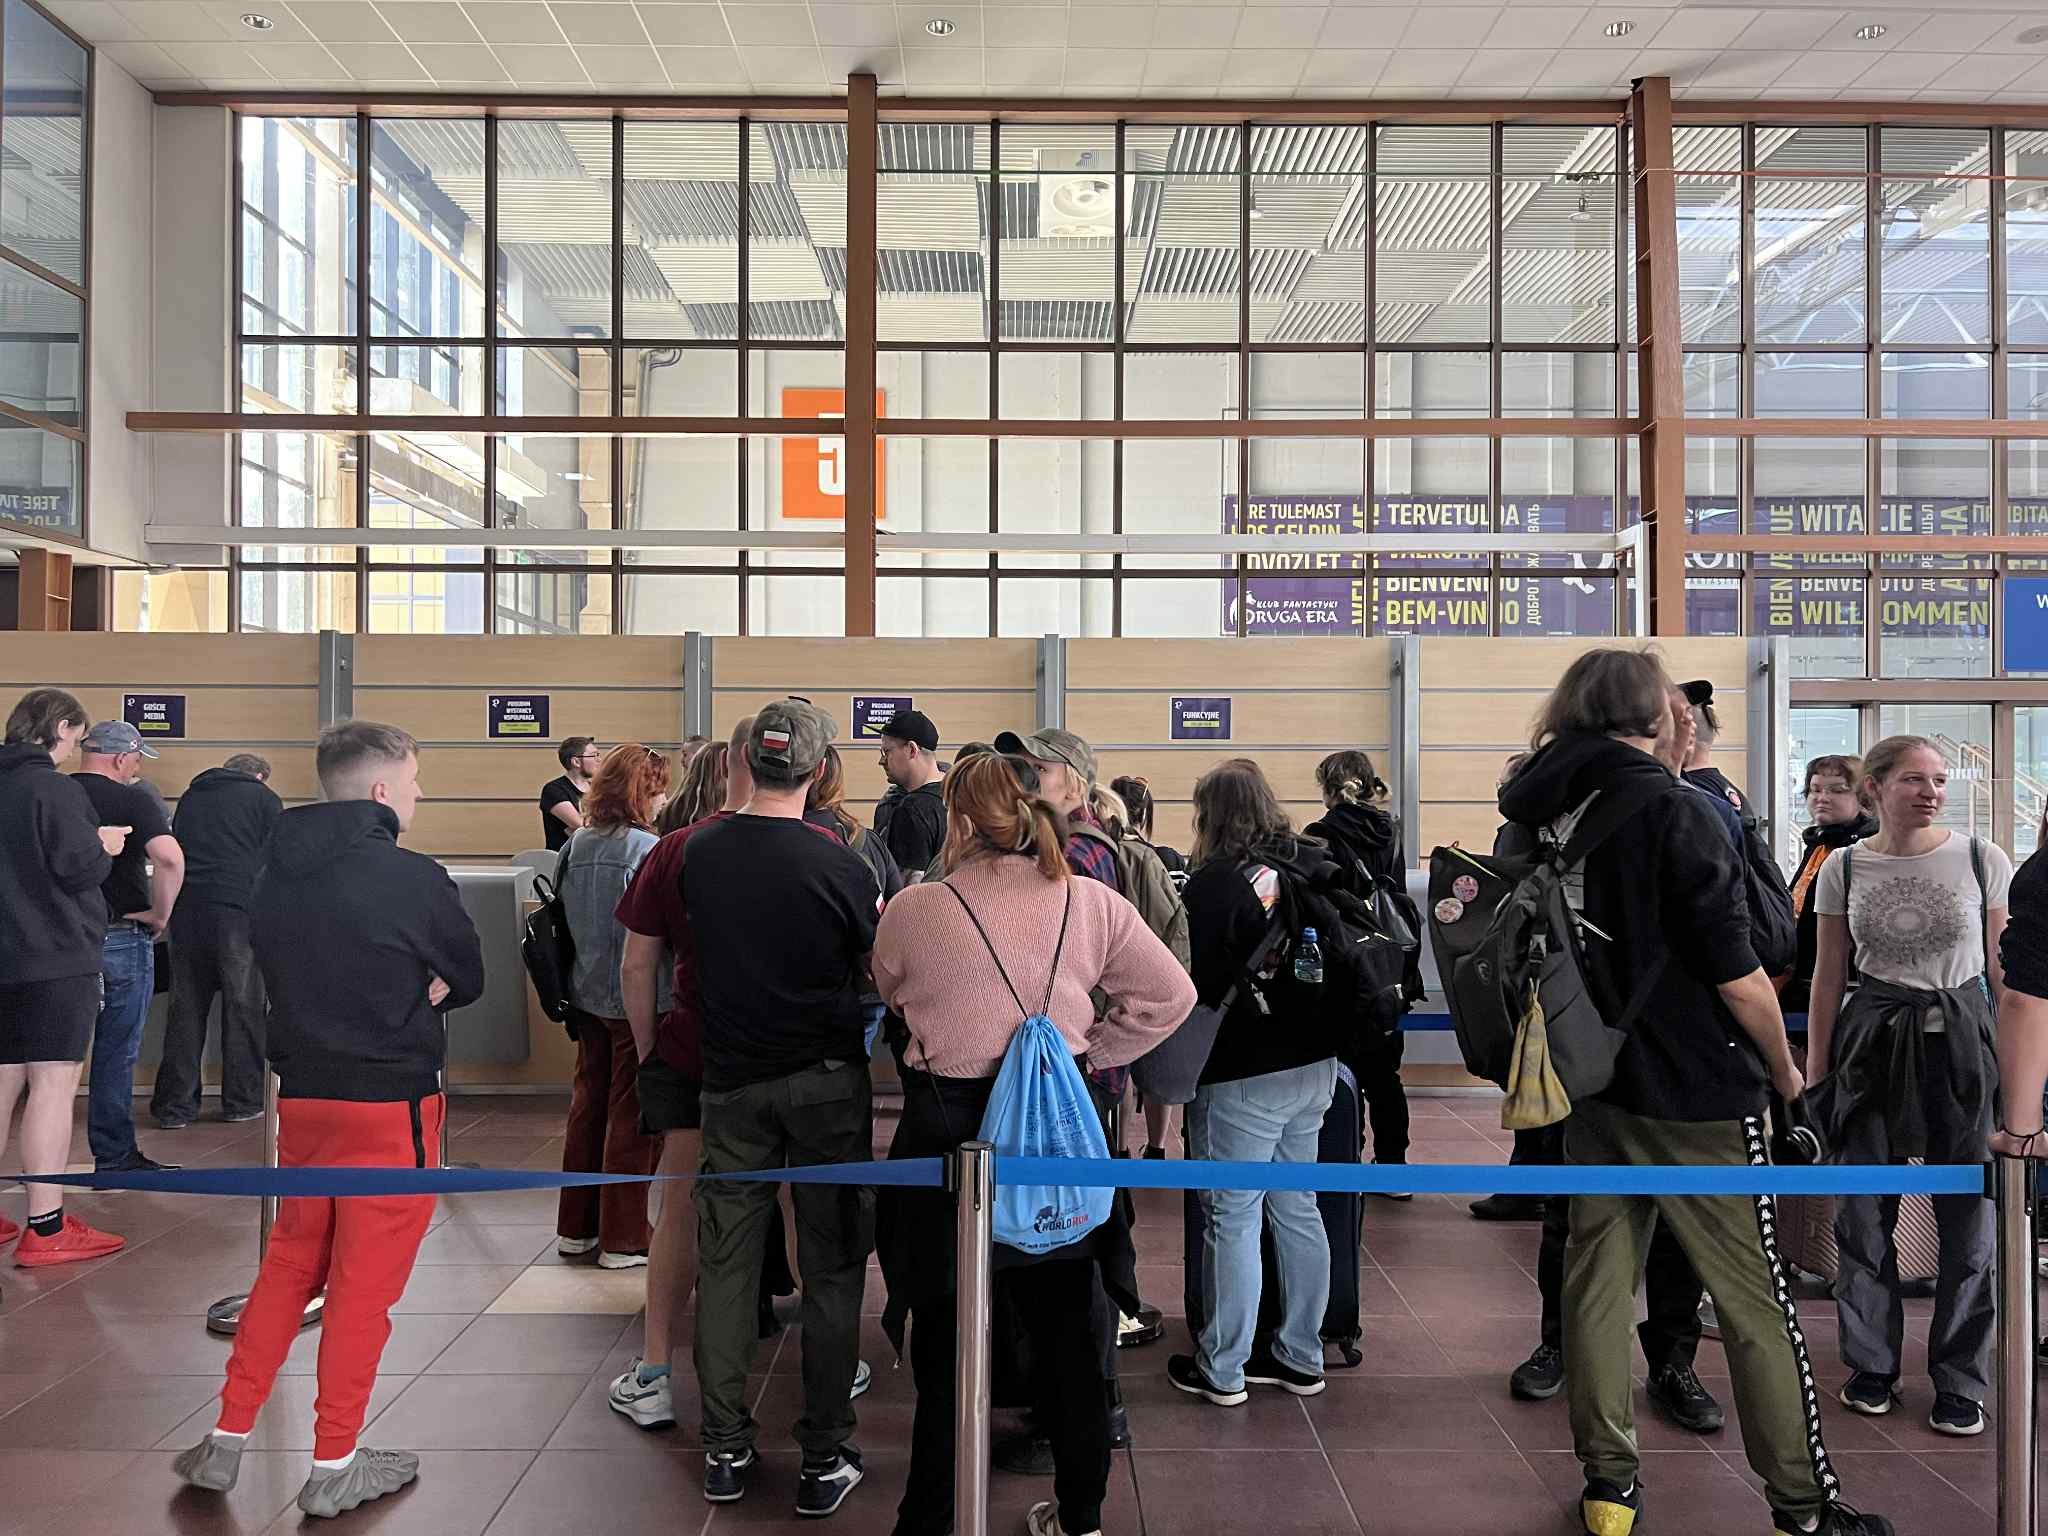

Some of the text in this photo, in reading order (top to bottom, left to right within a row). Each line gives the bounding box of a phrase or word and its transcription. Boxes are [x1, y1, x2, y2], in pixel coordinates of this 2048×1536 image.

[1232, 503, 1342, 519] TRE TULEMAST
[1388, 503, 1520, 525] TERVETULA
[1256, 600, 1338, 609] KLUB FANTASTYKI
[1306, 610, 1339, 623] ERA
[1386, 600, 1520, 625] BEM-VINO
[1801, 600, 1990, 625] WILLOMMEN
[144, 712, 166, 720] MEDIA
[1182, 711, 1220, 720] FUNKCYJNE
